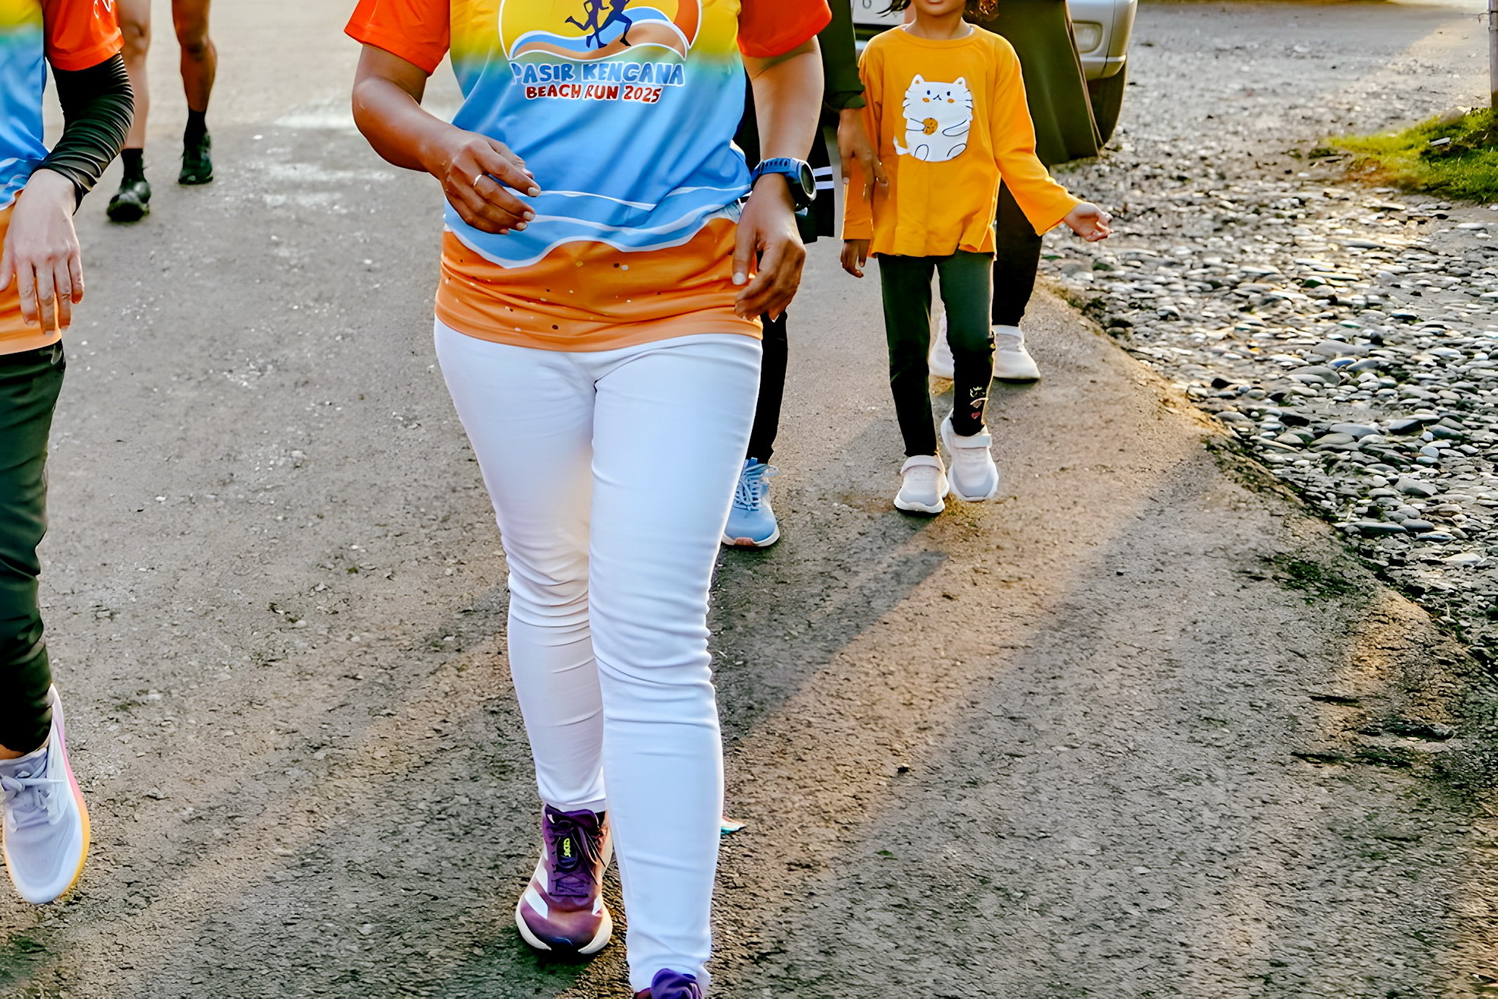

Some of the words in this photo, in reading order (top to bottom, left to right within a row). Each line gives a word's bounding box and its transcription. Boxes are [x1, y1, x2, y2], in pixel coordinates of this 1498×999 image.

[509, 61, 575, 84] PASIR
[581, 61, 686, 86] KENCANA
[525, 84, 582, 100] BEACH
[584, 84, 619, 100] RUN
[623, 85, 663, 104] 2025
